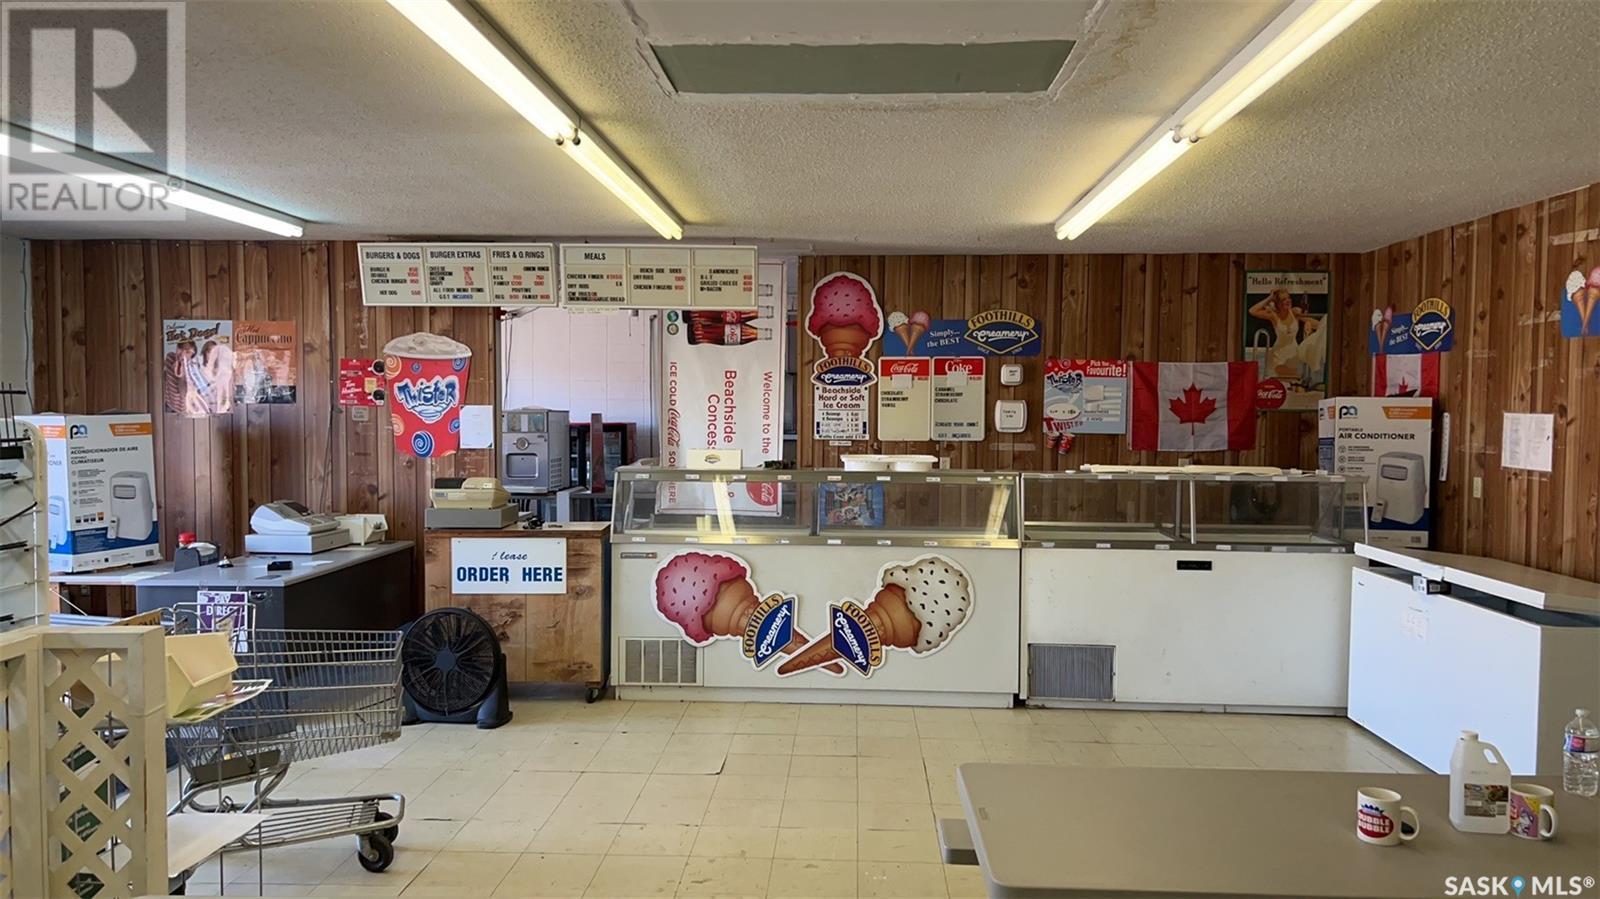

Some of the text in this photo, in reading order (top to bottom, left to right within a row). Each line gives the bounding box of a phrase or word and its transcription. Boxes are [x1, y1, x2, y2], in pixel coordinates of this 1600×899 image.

[366, 251, 395, 259] BURGERS
[430, 251, 481, 259] BURGER EXTRAS
[492, 251, 511, 259] FRIES
[512, 251, 517, 259] &
[584, 252, 606, 260] MEALS
[970, 311, 1033, 328] FOOTHILLS
[939, 337, 960, 347] BEST
[669, 362, 677, 377] ICE
[819, 357, 869, 371] FOOTHILLS
[944, 360, 973, 374] Coke
[1086, 363, 1127, 377] Favourite!
[669, 380, 677, 406] COLD
[723, 370, 737, 443] Beachside
[762, 371, 773, 454] Welcome to the
[836, 401, 861, 409] Cream
[457, 566, 563, 582] ORDER HERE
[745, 597, 780, 654] FOOTHILLS
[757, 604, 791, 658] Creamery
[845, 603, 880, 663] FOOTHILLS
[834, 612, 867, 666] Creamery
